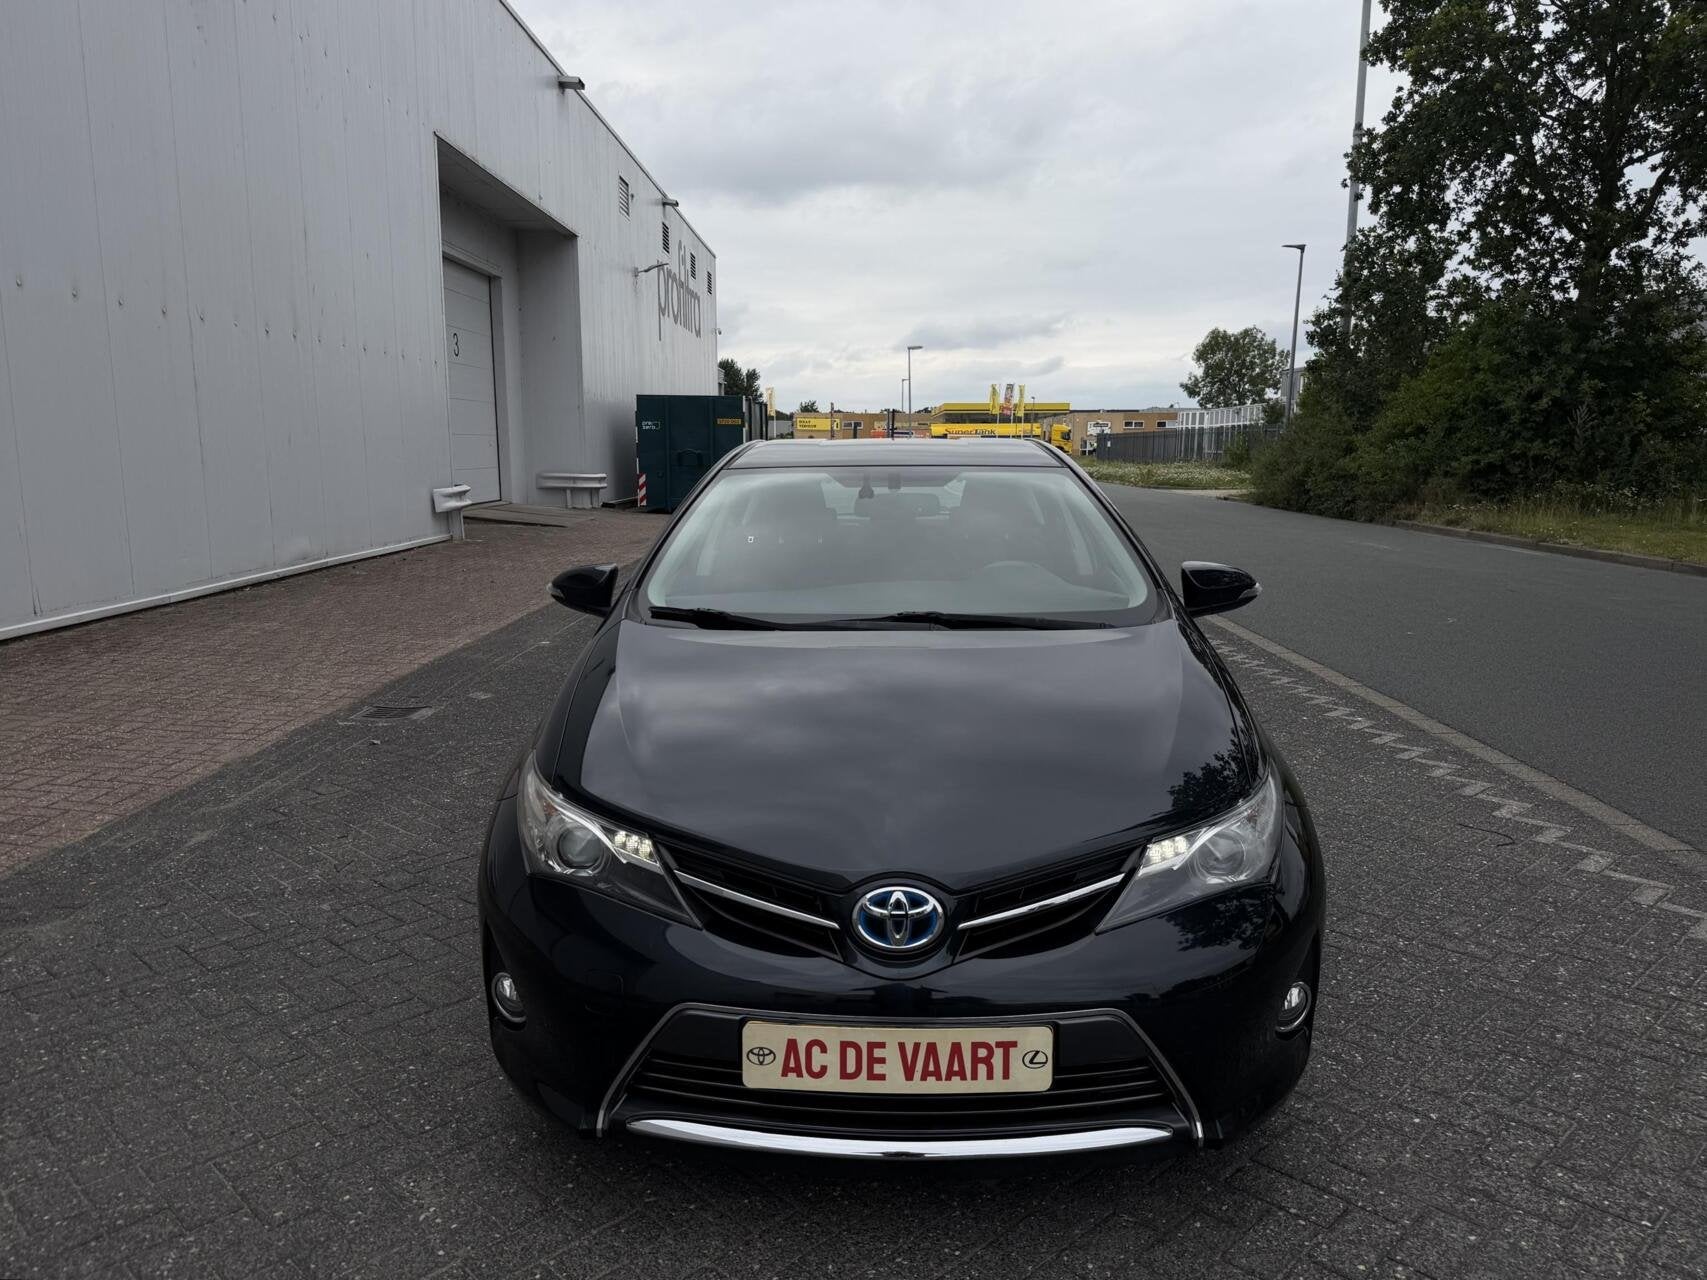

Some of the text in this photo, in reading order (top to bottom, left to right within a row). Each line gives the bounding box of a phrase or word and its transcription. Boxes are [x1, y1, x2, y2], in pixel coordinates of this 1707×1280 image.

[657, 240, 701, 341] profiltra
[453, 332, 460, 357] 3
[781, 1038, 1018, 1082] AC DE VAART
